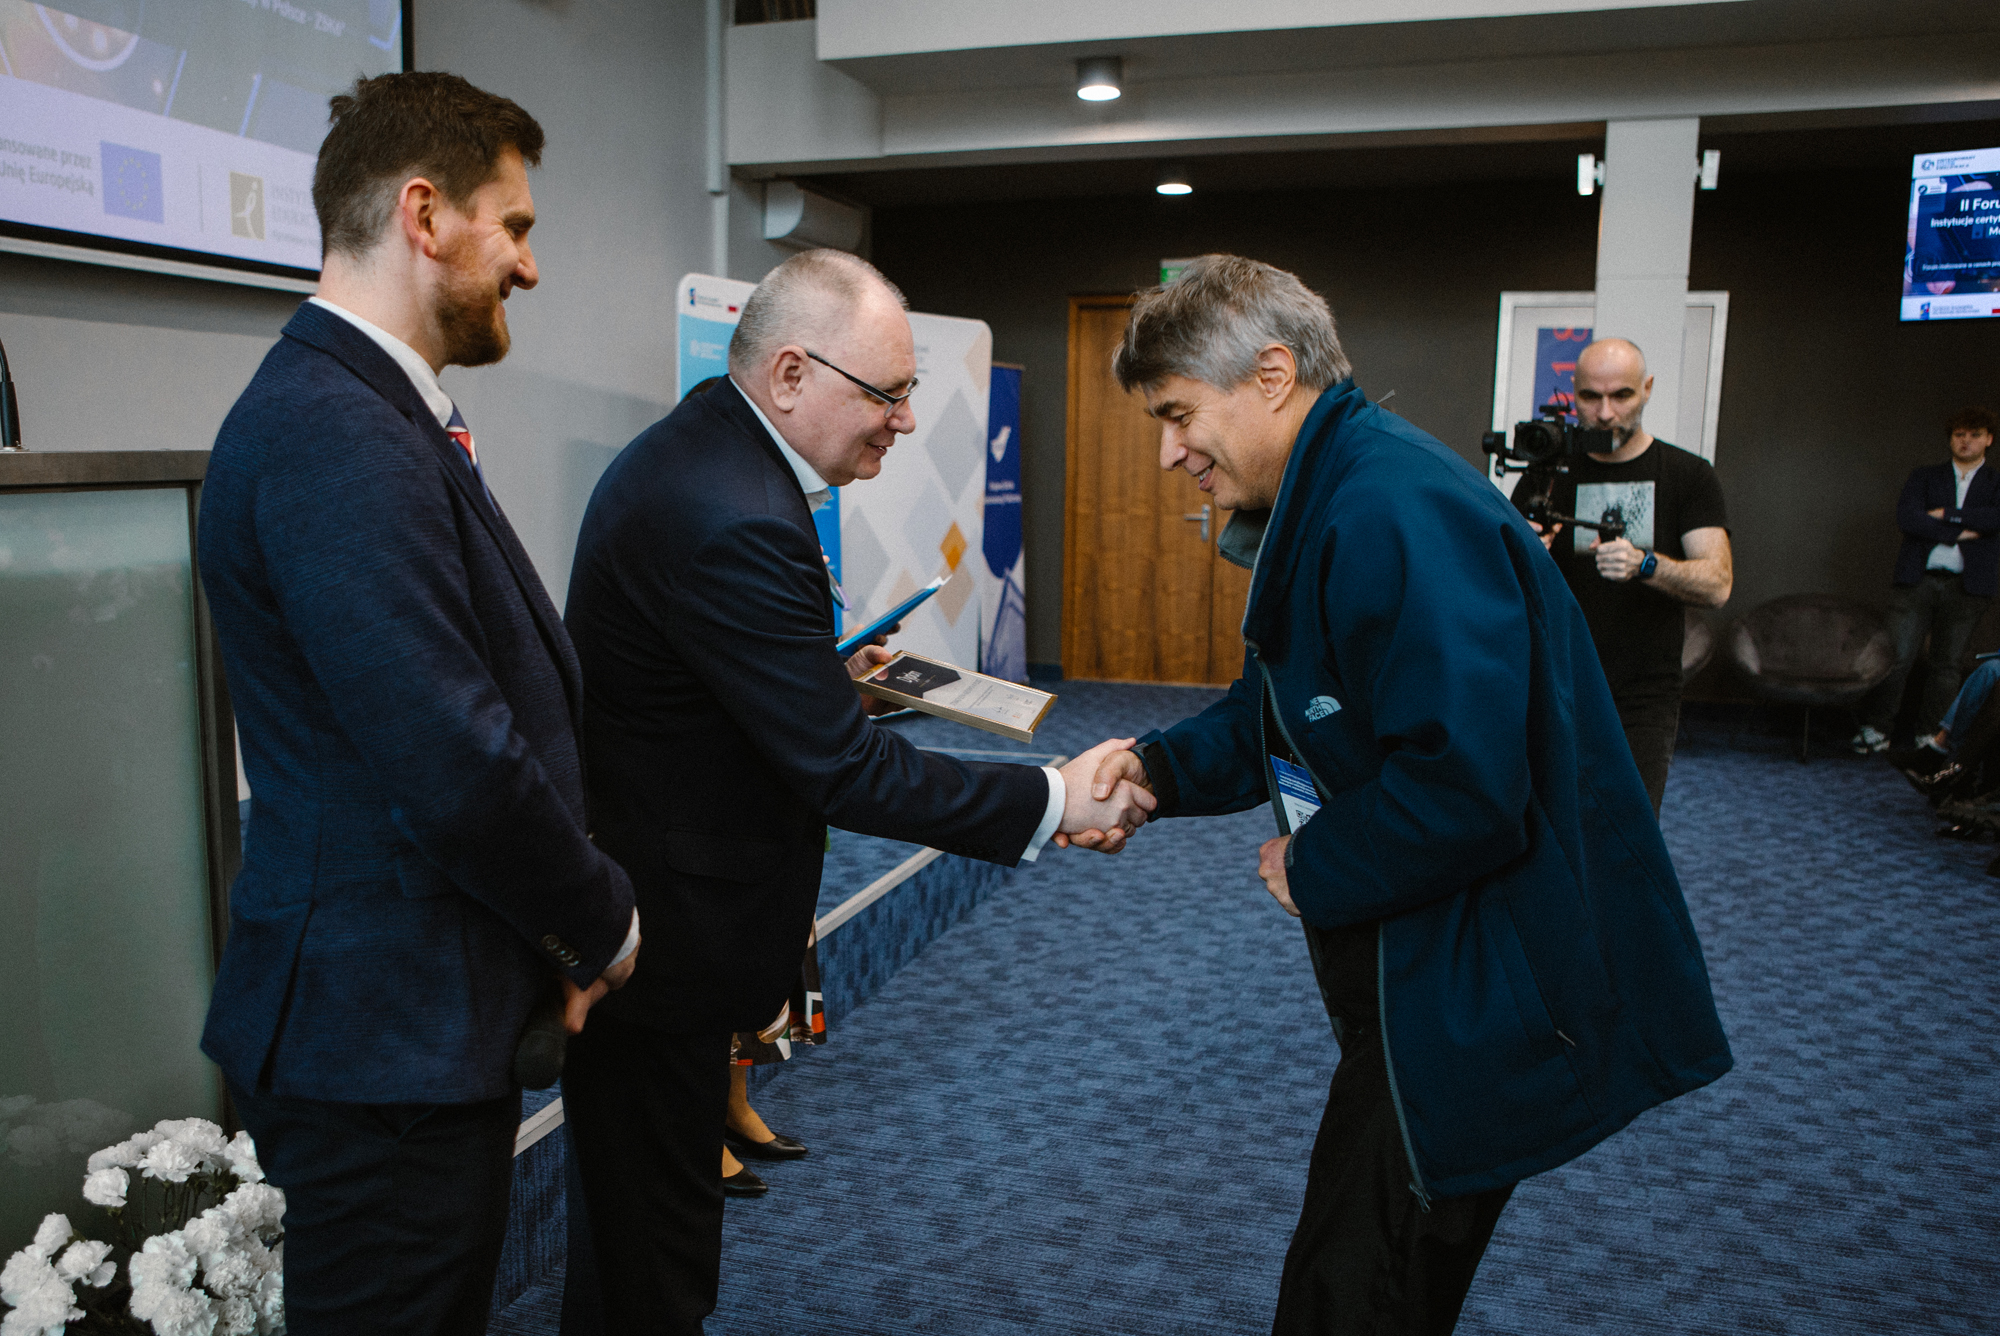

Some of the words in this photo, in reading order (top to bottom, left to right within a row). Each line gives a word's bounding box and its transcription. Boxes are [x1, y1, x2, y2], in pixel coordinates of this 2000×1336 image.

[61, 150, 92, 170] przez
[1960, 198, 1970, 212] II
[1930, 215, 1974, 229] Instytucje
[1309, 710, 1327, 723] FACE
